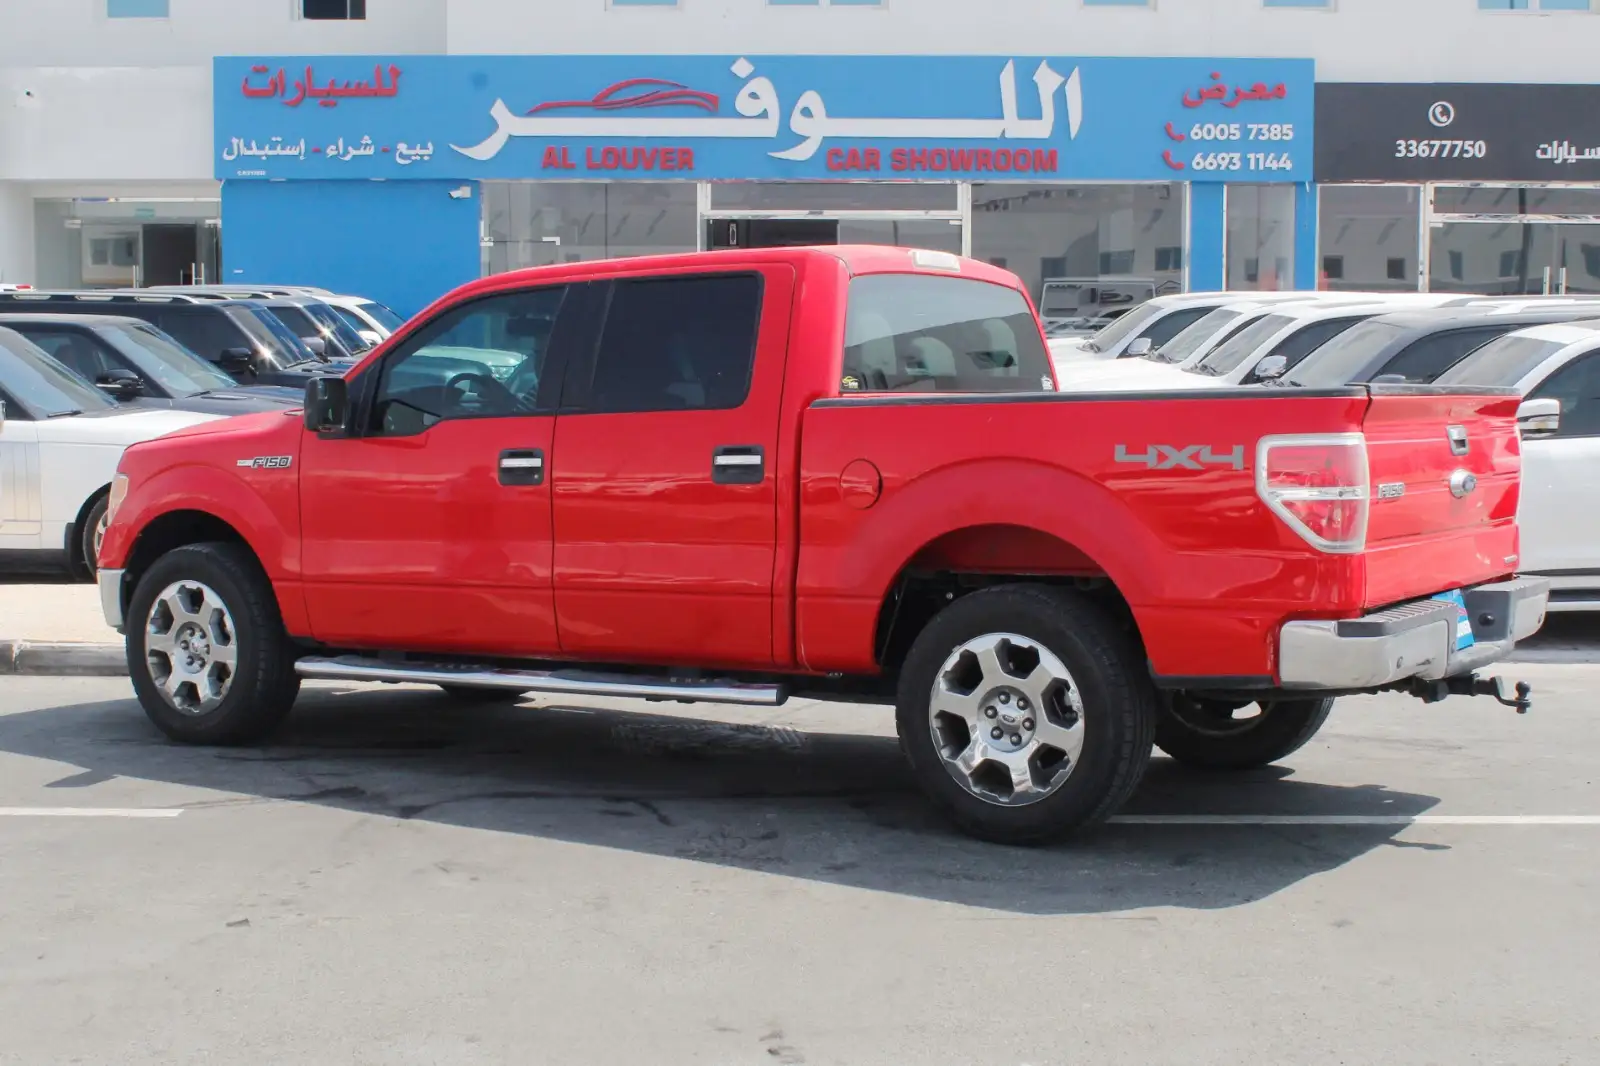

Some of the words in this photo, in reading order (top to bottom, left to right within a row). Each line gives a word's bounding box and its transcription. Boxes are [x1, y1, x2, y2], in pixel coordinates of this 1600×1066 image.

[241, 64, 402, 107] للسيارات
[1182, 72, 1286, 108] معرض
[1190, 123, 1240, 141] 6005
[1247, 123, 1293, 141] 7385
[326, 135, 375, 160] شراء
[395, 141, 434, 165] بيع
[542, 146, 576, 169] AL
[586, 146, 694, 170] LOUVER
[1395, 140, 1486, 158] 33677750
[826, 148, 880, 171] CAR
[890, 148, 1058, 172] SHOWROOM
[1192, 153, 1241, 171] 6693
[1247, 153, 1292, 171] 1144
